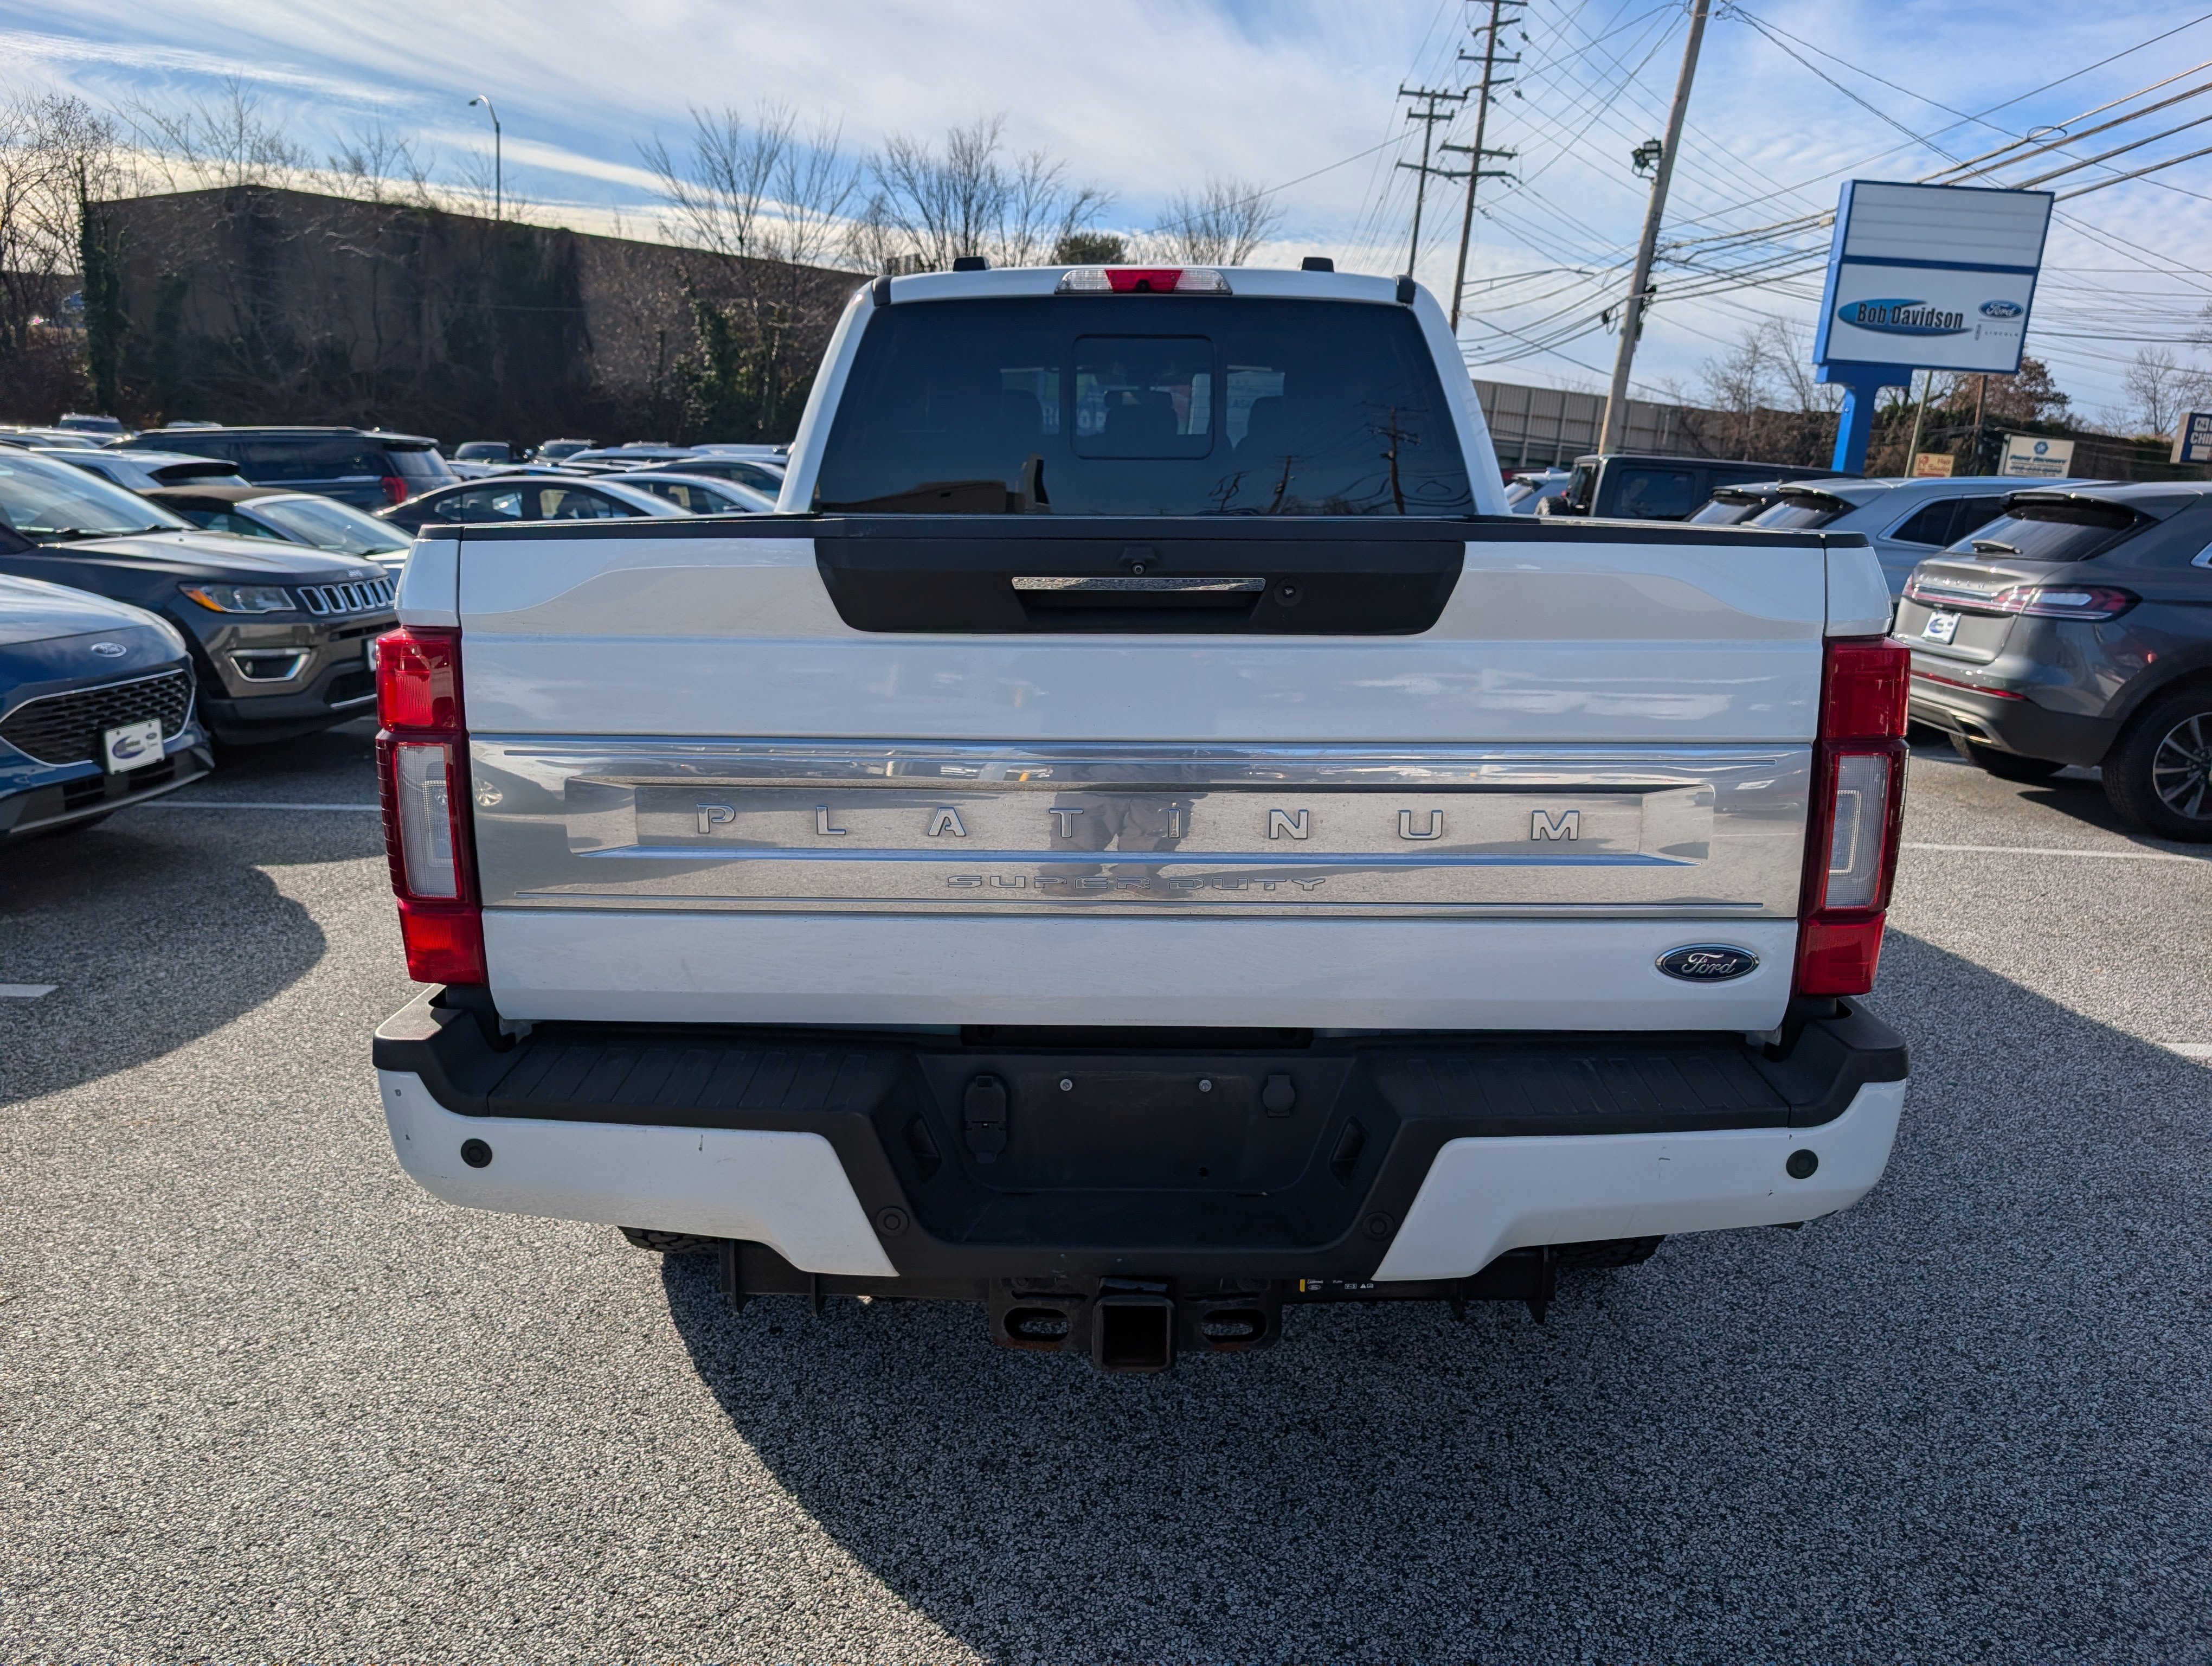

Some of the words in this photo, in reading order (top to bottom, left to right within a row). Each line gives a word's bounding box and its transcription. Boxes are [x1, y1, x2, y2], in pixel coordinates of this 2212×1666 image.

[1856, 304, 1887, 324] Bob
[1891, 306, 1964, 329] Davidson
[1986, 303, 2016, 316] Ford
[2190, 432, 2212, 444] CHI
[697, 803, 1580, 841] PLATINUM
[947, 875, 1151, 890] SUPER
[1169, 876, 1326, 892] DUTY
[1681, 952, 1738, 974] Ford
